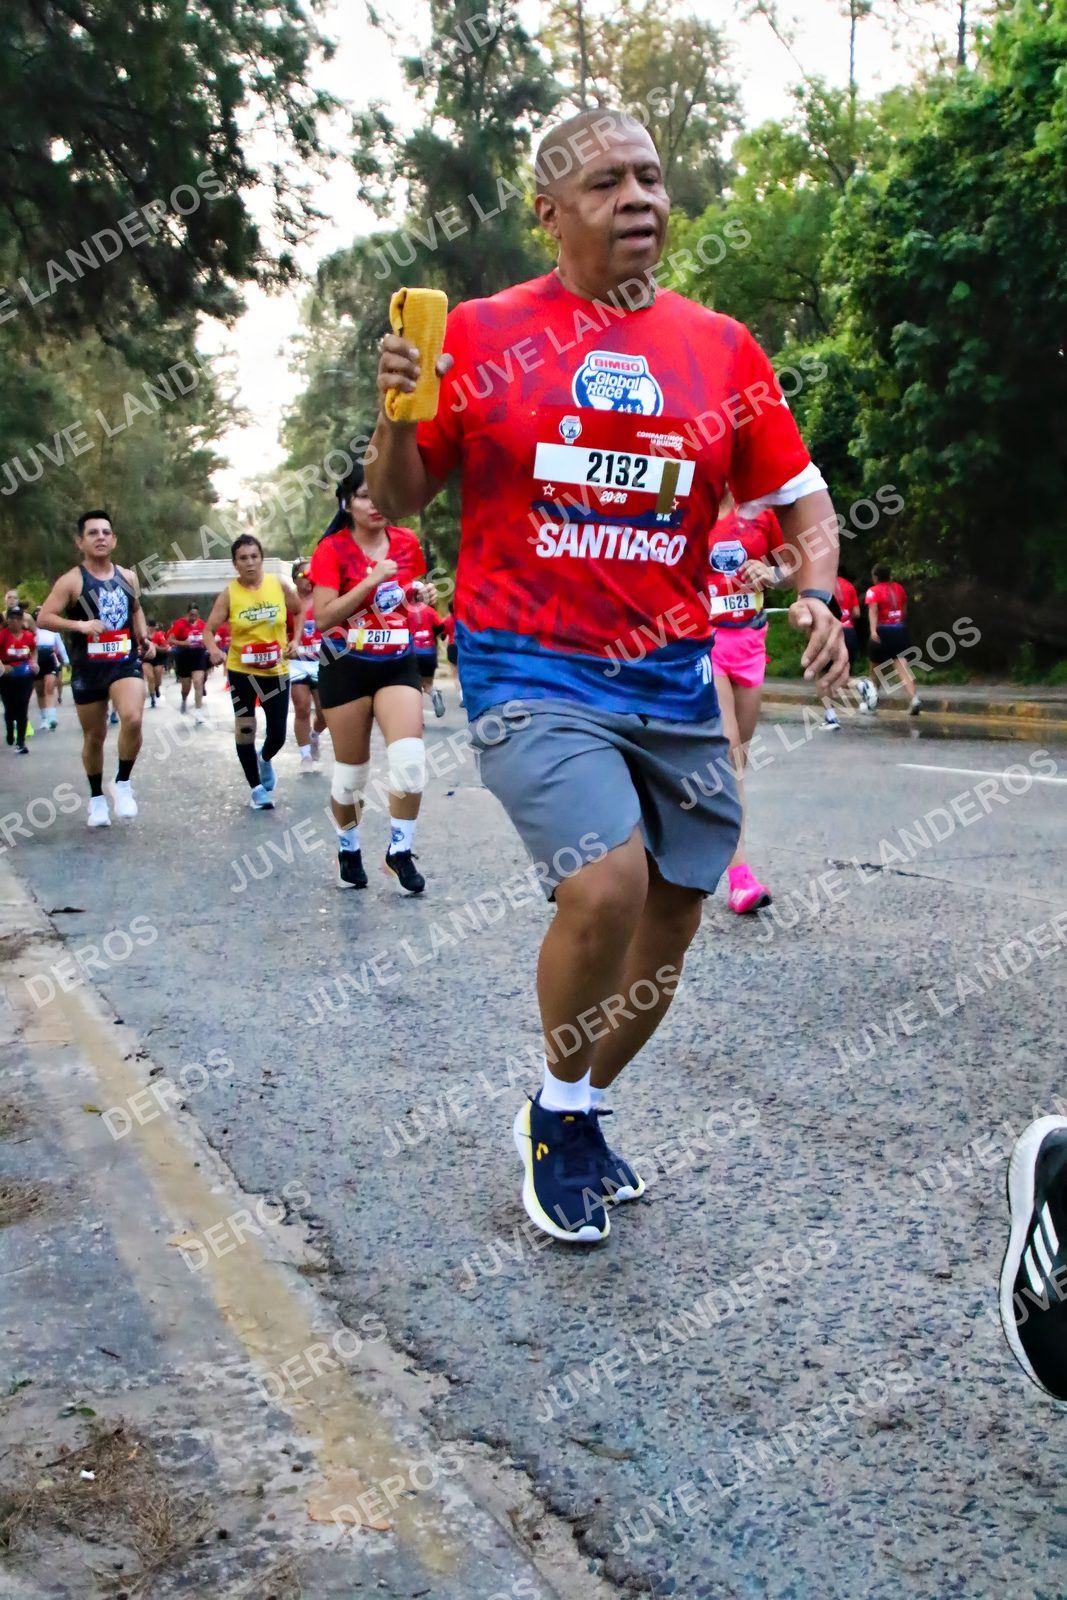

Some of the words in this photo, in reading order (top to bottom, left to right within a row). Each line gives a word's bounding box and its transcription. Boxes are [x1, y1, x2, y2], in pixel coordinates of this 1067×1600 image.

[595, 358, 640, 372] BIMBO
[586, 381, 623, 399] Race
[596, 372, 640, 391] Global
[586, 451, 648, 489] 2132
[536, 522, 687, 566] SANTIAGO
[723, 594, 749, 610] 1623
[368, 630, 391, 643] 2617
